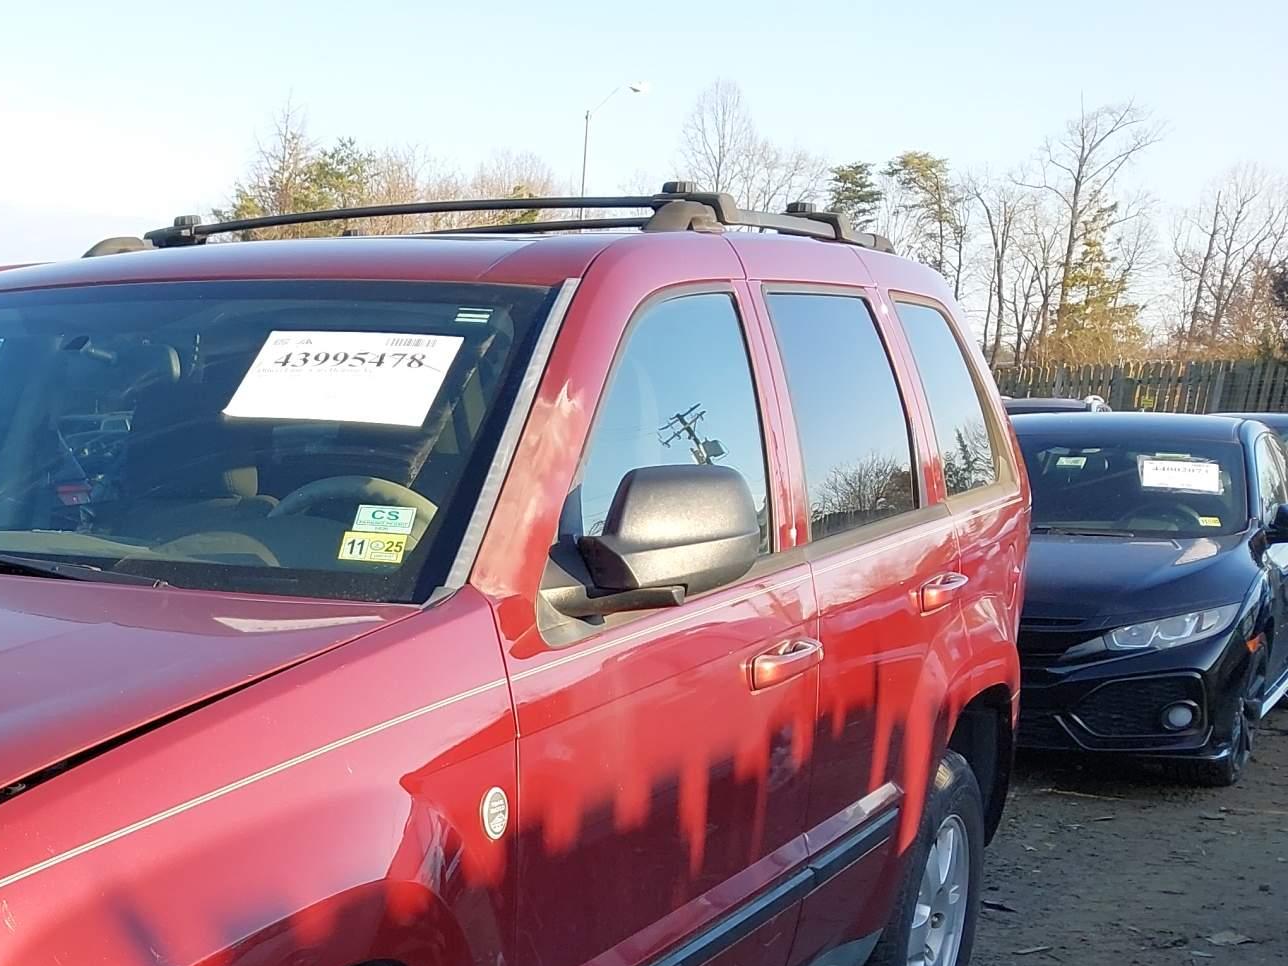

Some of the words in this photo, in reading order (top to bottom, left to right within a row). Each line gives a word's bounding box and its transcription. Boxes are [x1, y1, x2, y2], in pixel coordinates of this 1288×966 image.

[273, 351, 427, 368] 43995478
[371, 509, 400, 521] CS
[347, 538, 366, 556] 11
[384, 540, 404, 553] 25
